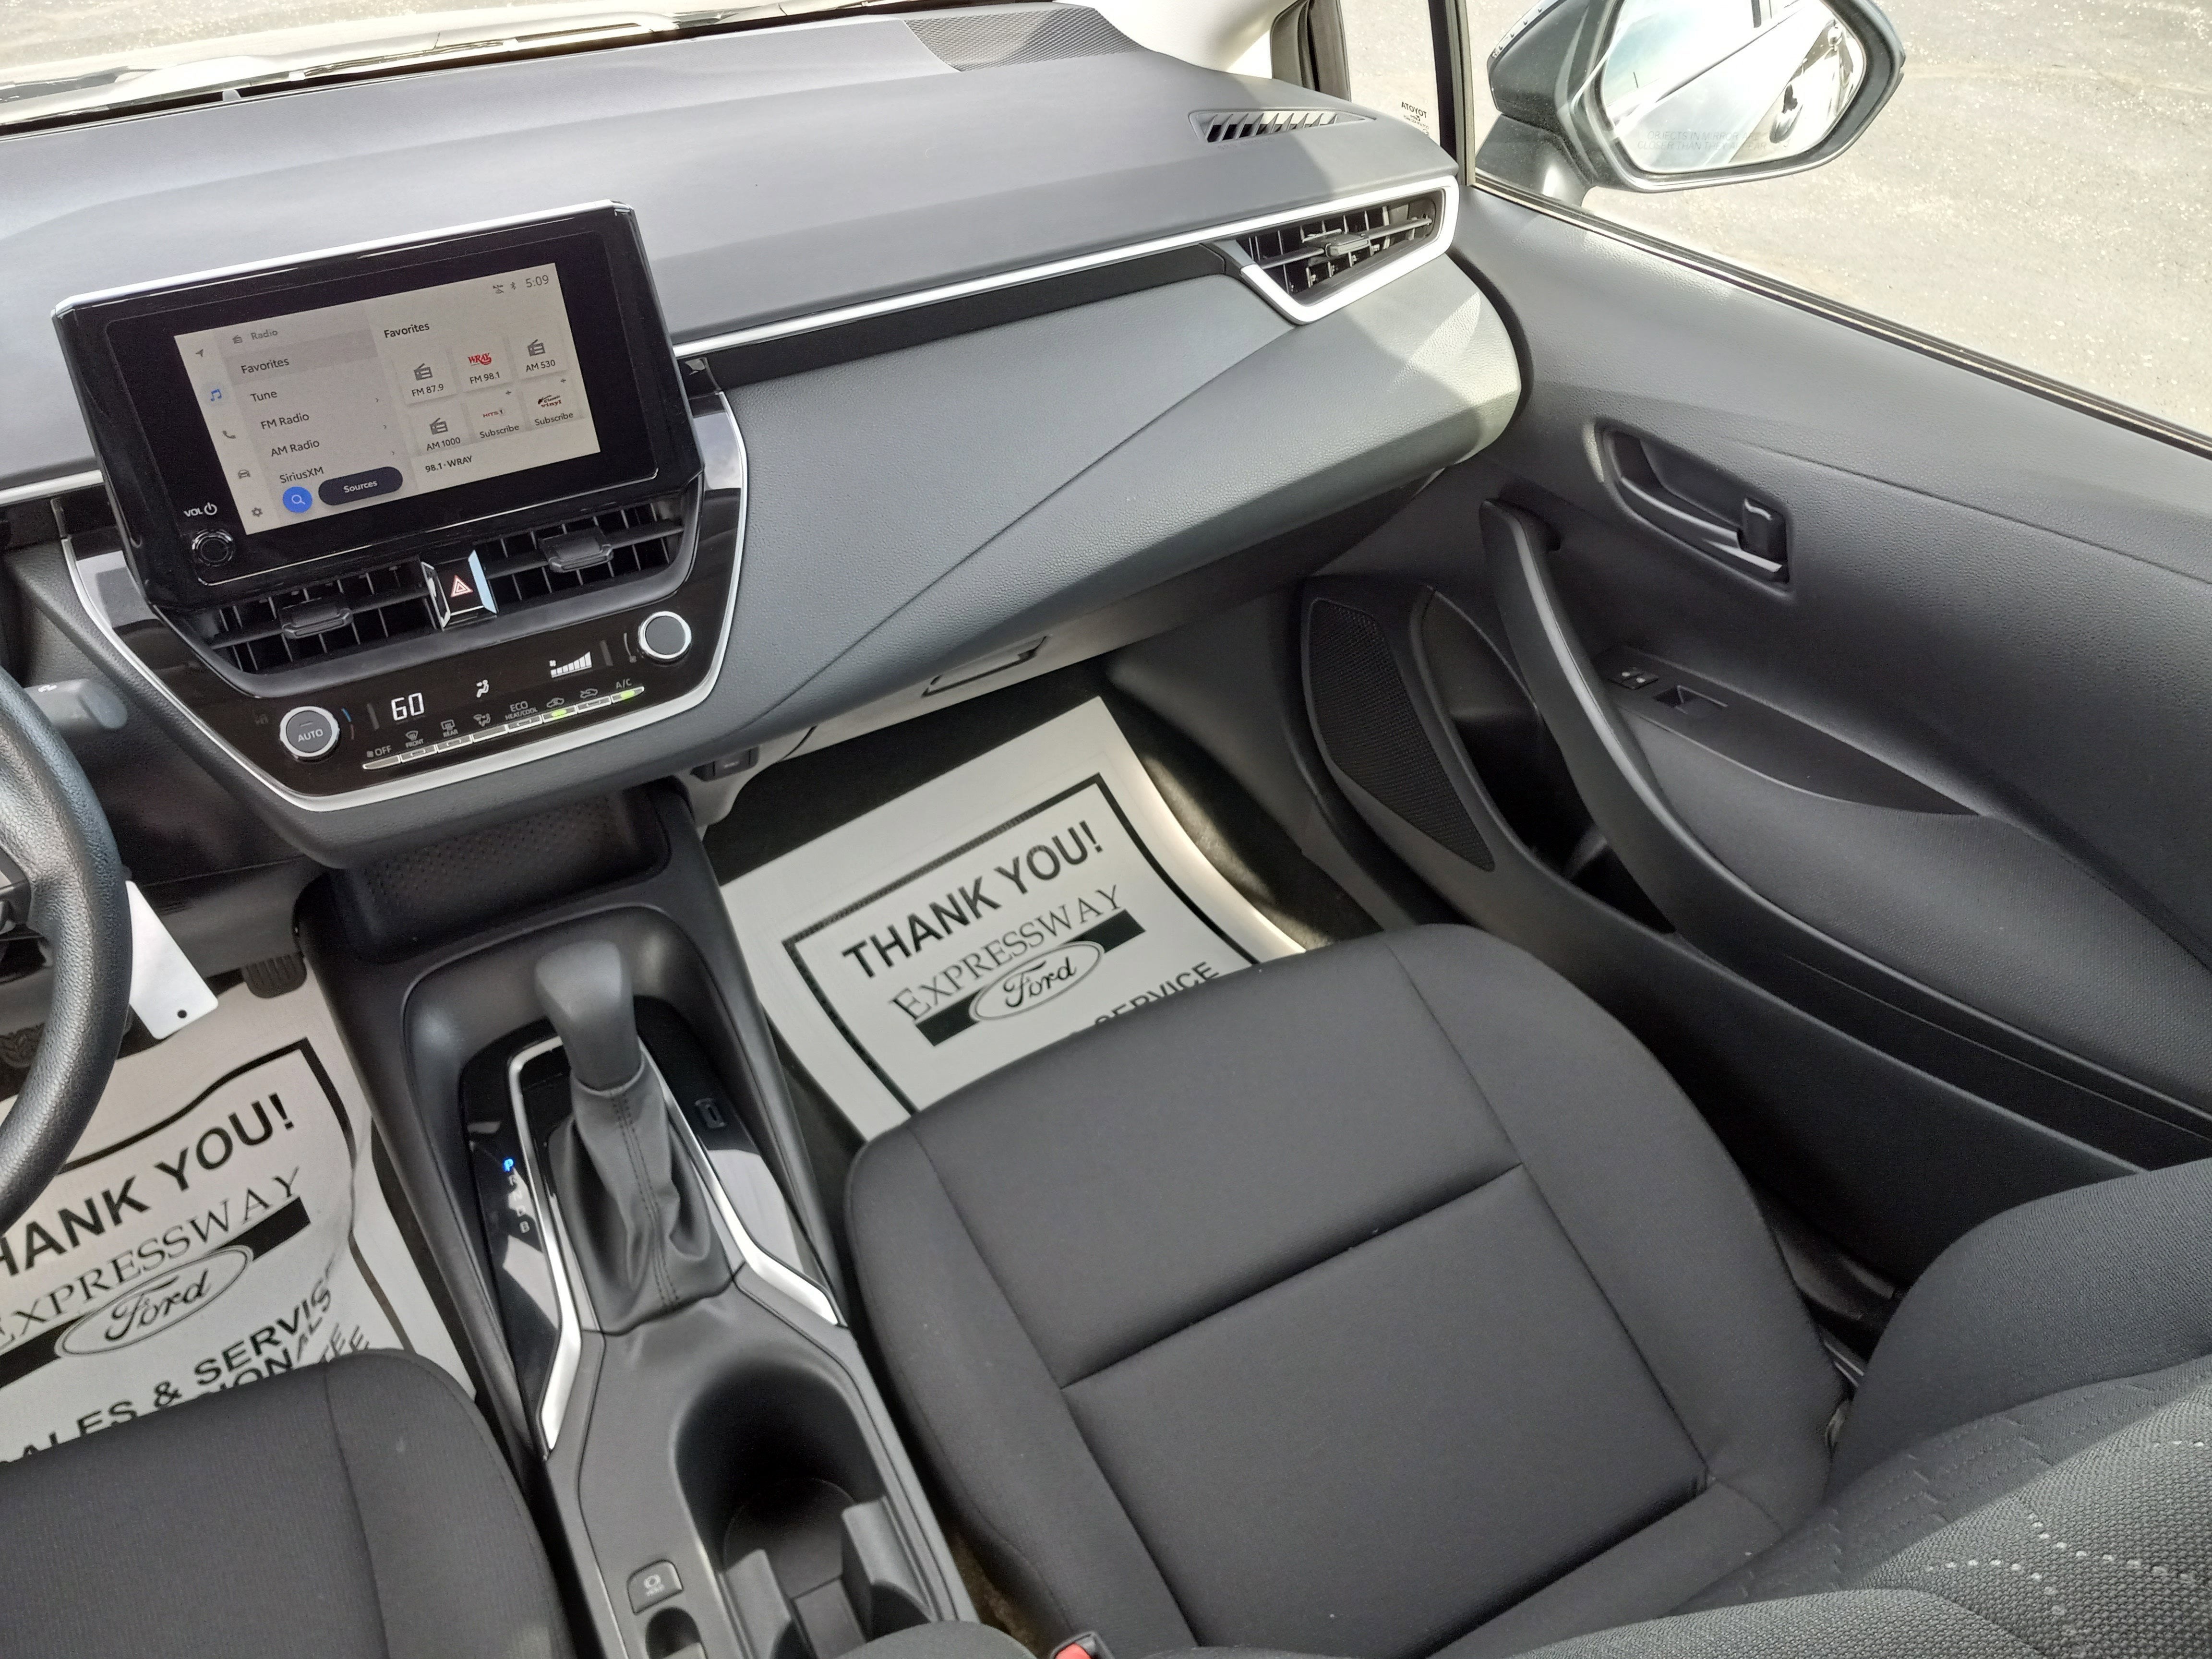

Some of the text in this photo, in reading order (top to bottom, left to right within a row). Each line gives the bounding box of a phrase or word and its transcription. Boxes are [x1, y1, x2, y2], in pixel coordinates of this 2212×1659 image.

[1647, 131, 1687, 140] OBJECTS
[1690, 131, 1700, 140] IN
[1637, 141, 1674, 150] CLOSER
[1677, 141, 1701, 150] THAN
[526, 275, 550, 289] 5:09
[251, 329, 278, 340] Radio
[384, 323, 430, 338] Favorites
[241, 358, 289, 373] Favorites
[526, 360, 555, 372] AM 530
[469, 371, 500, 384] FM 98.1
[250, 390, 277, 402] Tune
[411, 384, 444, 397] FM 87.9
[261, 413, 310, 430] FM Radio
[534, 412, 574, 426] Subscribe
[480, 424, 519, 439] Subscribe
[271, 440, 320, 457] AM Radio
[426, 437, 461, 451] AM 1000
[447, 456, 472, 468] WRAY
[279, 467, 324, 484] SiriusXM
[343, 480, 378, 493] Sources
[183, 508, 203, 517] VOL
[615, 678, 632, 689] A/C
[391, 693, 424, 721] 60
[505, 707, 538, 720] HEAT/COOL
[509, 701, 529, 712] ECO
[297, 728, 324, 743] AUTO
[443, 729, 458, 738] REAR
[405, 738, 424, 748] FRONT
[374, 745, 392, 757] OFF
[842, 820, 1104, 979] THANK YOU!
[889, 884, 1124, 1022] EXPRESSWAY
[1003, 956, 1077, 1008] Ford
[154, 1093, 295, 1192] YOU!
[504, 1158, 514, 1172] P
[0, 1166, 299, 1350] XPRESSWAY
[105, 1268, 212, 1341] Ford
[154, 1381, 182, 1407] &
